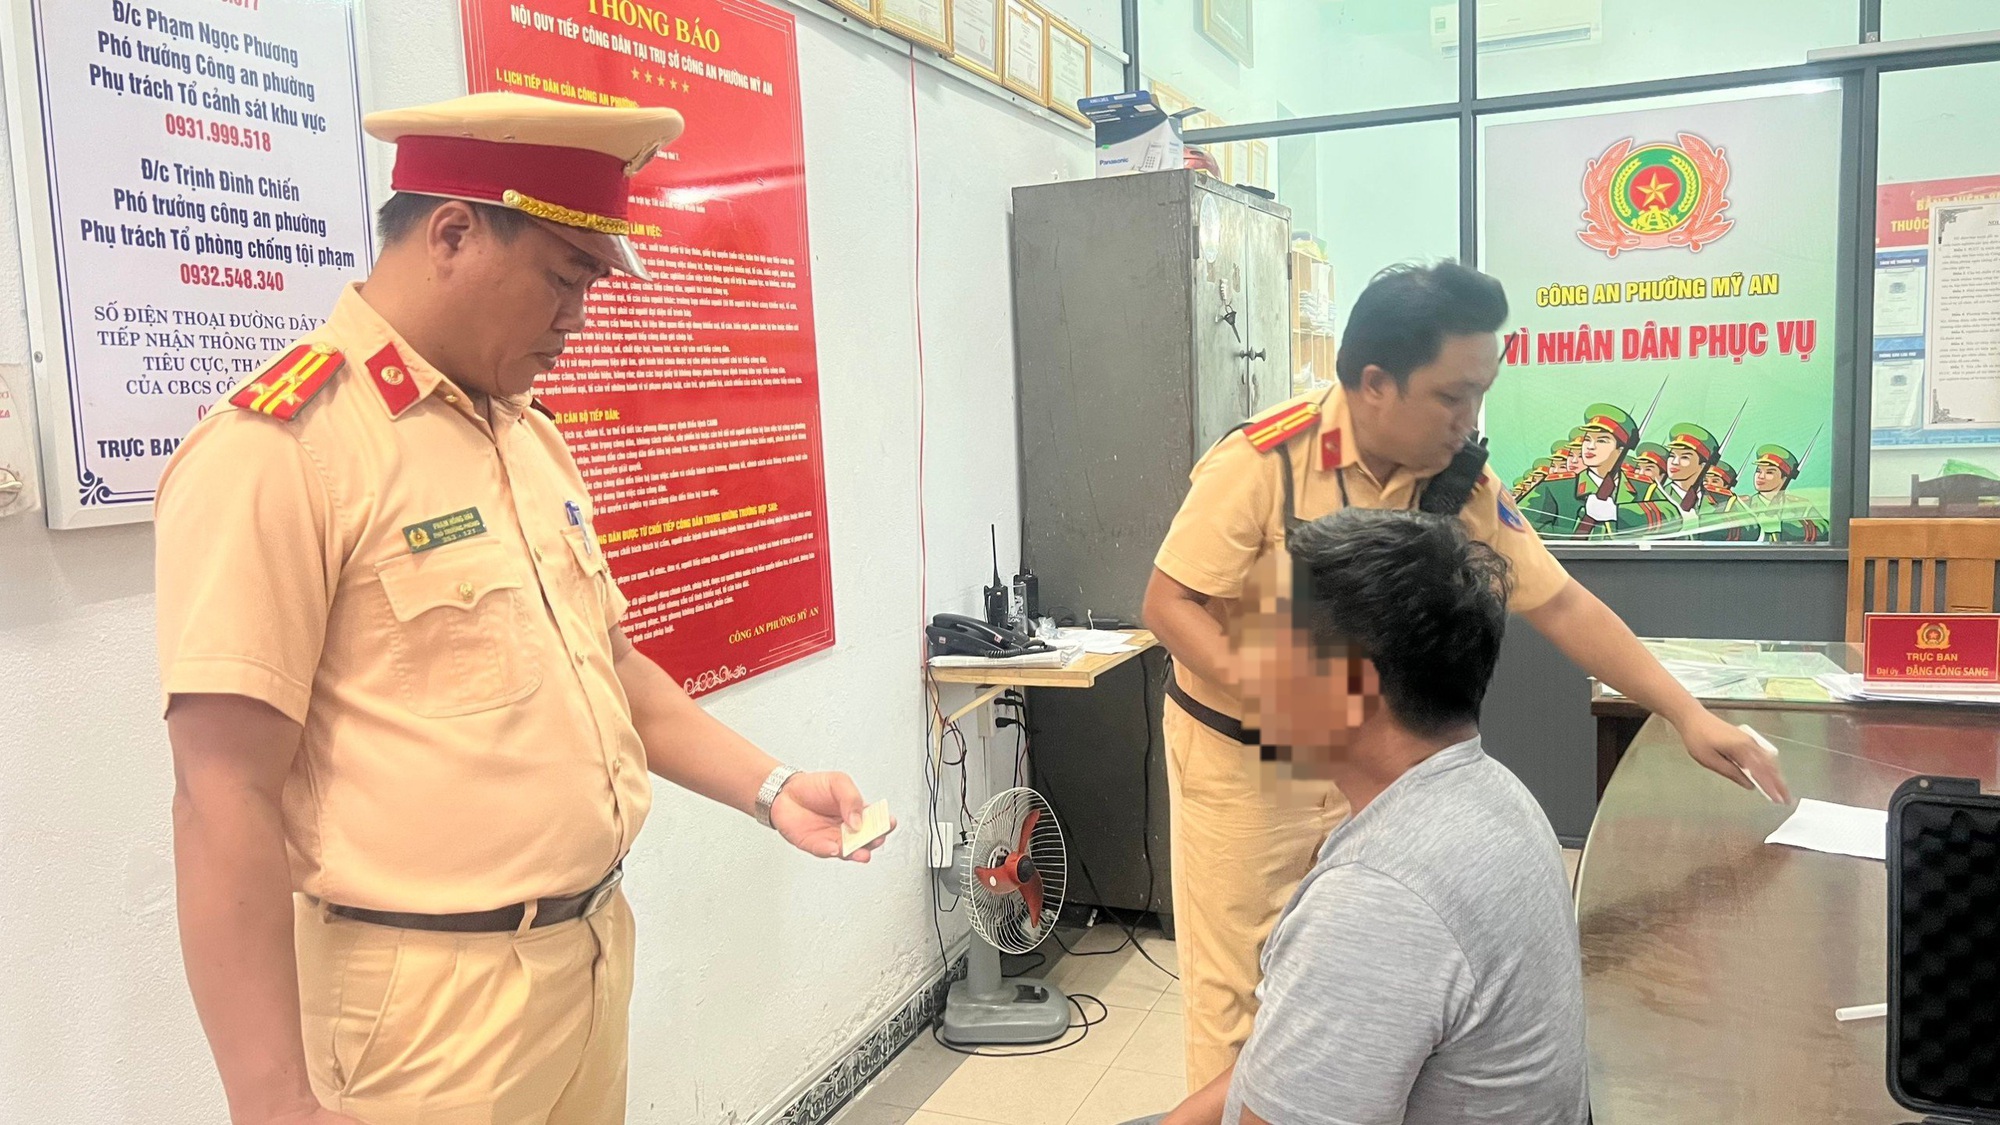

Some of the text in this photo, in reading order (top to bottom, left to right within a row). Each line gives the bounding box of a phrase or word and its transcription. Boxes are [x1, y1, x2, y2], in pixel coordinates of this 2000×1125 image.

[112, 0, 298, 68] Đ/c Phạm Ngọc Phương
[510, 4, 531, 28] NỘI
[534, 12, 554, 32] QUY
[557, 18, 579, 39] TIẾP
[582, 25, 609, 48] CÔNG
[611, 34, 631, 55] DÂN
[633, 41, 648, 62] TẠI
[649, 46, 666, 68] TRỤ
[668, 50, 680, 69] SỞ
[681, 55, 704, 76] CÔNG
[706, 64, 717, 80] AN
[718, 67, 749, 89] PHƯỜNG
[762, 81, 773, 96] AN
[675, 17, 720, 53] BÁO
[98, 30, 314, 102] Phó trưởng Công an phường
[89, 64, 326, 134] Phụ trách Tổ cảnh sát khu vực
[166, 113, 271, 152] 0931.999.518
[141, 158, 299, 201] Đ/c Trịnh Đình Chiến
[1100, 157, 1128, 166] Panasonic
[114, 188, 326, 237] Phó trưởng công an phường
[1891, 217, 1929, 233] THUỘC
[80, 219, 354, 270] Phụ trách Tổ phòng chống tội phạm
[180, 264, 284, 291] 0932.548.340
[1537, 272, 1779, 308] CÔNG AN PHƯỜNG MỸ AN
[94, 301, 317, 331] SỐ ĐIỆN THOẠI ĐƯỜNG DÂY
[97, 326, 286, 351] TIẾP NHẬN THÔNG TIN
[1504, 320, 1816, 365] VÌ NHÂN DÂN PHỤC VỤ
[143, 354, 266, 374] TIÊU CỰC, THA
[126, 374, 239, 395] CỦA CBCS CÔ
[97, 438, 144, 461] TRỰC
[729, 630, 752, 644] CÔNG
[753, 624, 765, 636] AN
[766, 615, 796, 632] PHƯỜNG
[809, 606, 819, 617] AN
[1906, 652, 1958, 662] TRỰC BAN
[1935, 665, 1961, 676] CÔNG
[1962, 667, 1989, 676] SANG
